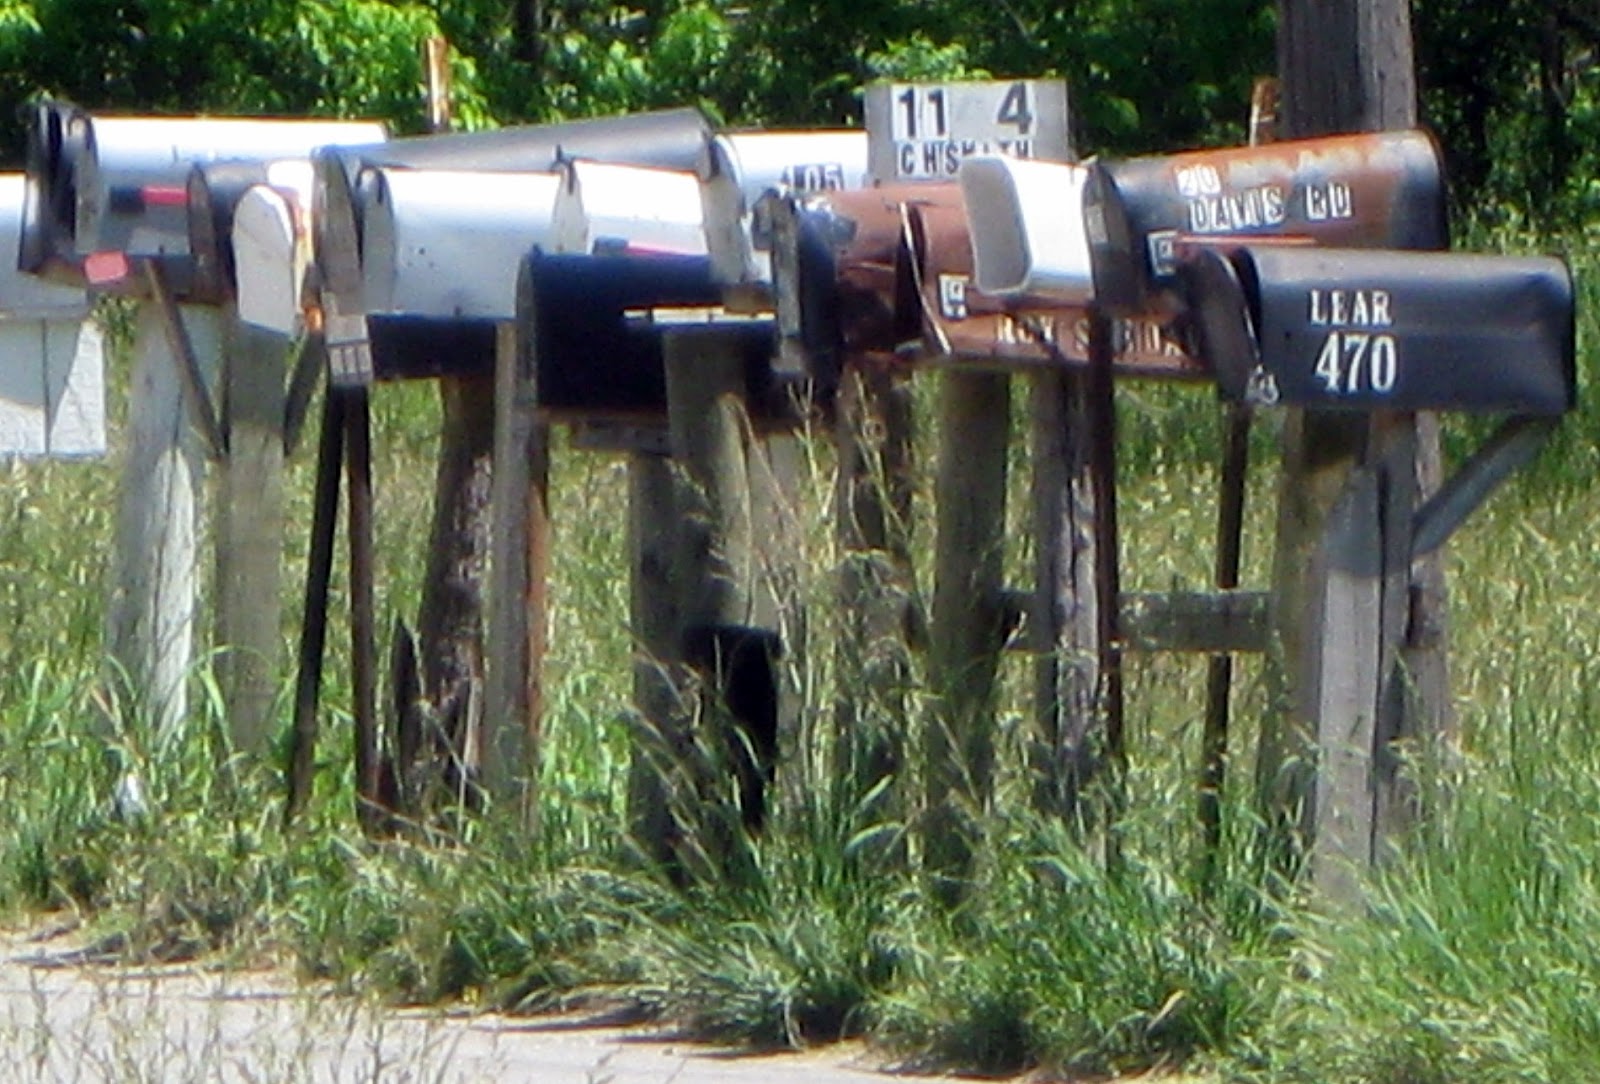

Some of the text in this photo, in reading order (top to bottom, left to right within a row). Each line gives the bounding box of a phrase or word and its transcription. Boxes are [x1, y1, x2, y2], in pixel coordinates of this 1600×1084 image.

[898, 81, 1033, 138] 11 4
[1191, 183, 1351, 231] DAVIS RD
[1309, 288, 1393, 325] LEAR
[1315, 330, 1396, 393] 470
